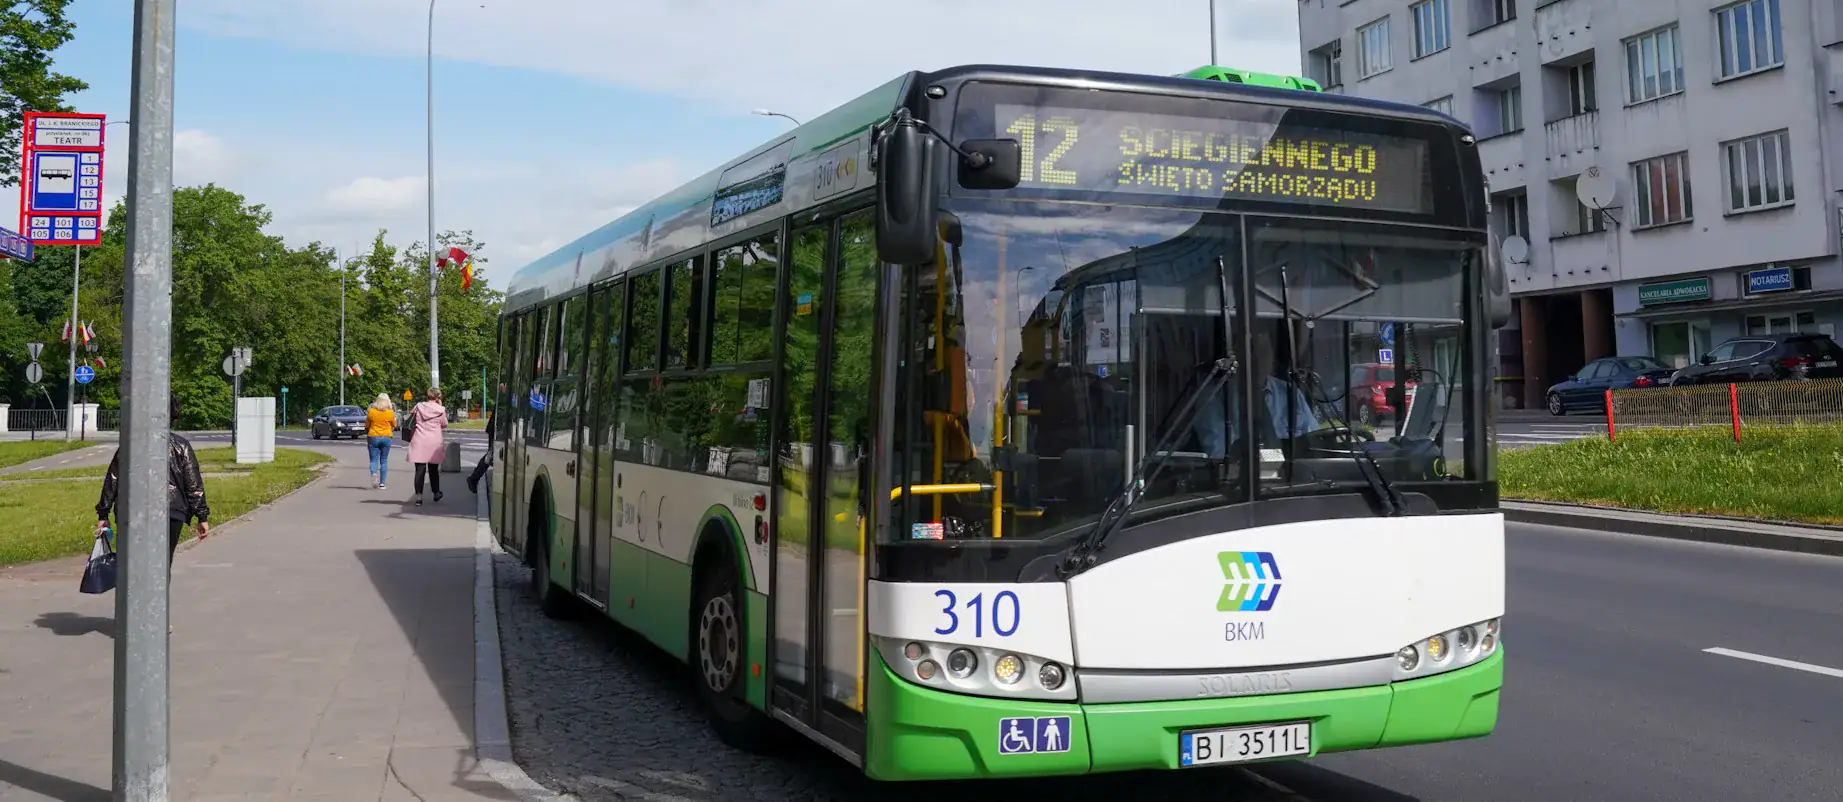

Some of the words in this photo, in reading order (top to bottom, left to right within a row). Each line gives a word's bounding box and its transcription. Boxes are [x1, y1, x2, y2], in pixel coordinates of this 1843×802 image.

[1006, 113, 1079, 185] 12
[85, 166, 95, 174] 12
[817, 161, 833, 189] 310
[84, 178, 94, 186] 13
[1117, 159, 1213, 192] ŚWIĘTO
[1221, 169, 1376, 203] SAMORZĄDU
[83, 201, 94, 209] 17
[56, 219, 71, 227] 101
[80, 219, 96, 227] 103
[32, 230, 48, 238] 105
[56, 230, 71, 238] 106
[1751, 273, 1790, 286] NOTARIUSZ
[1640, 288, 1672, 299] KANCELARIA
[1673, 285, 1707, 297] ADWOKACKA
[934, 589, 1020, 638] 310
[1225, 621, 1265, 641] BKM
[1197, 672, 1293, 697] SOLARIS
[1196, 734, 1225, 761] BI
[1239, 727, 1305, 756] 3511L
[1182, 752, 1193, 760] PL
